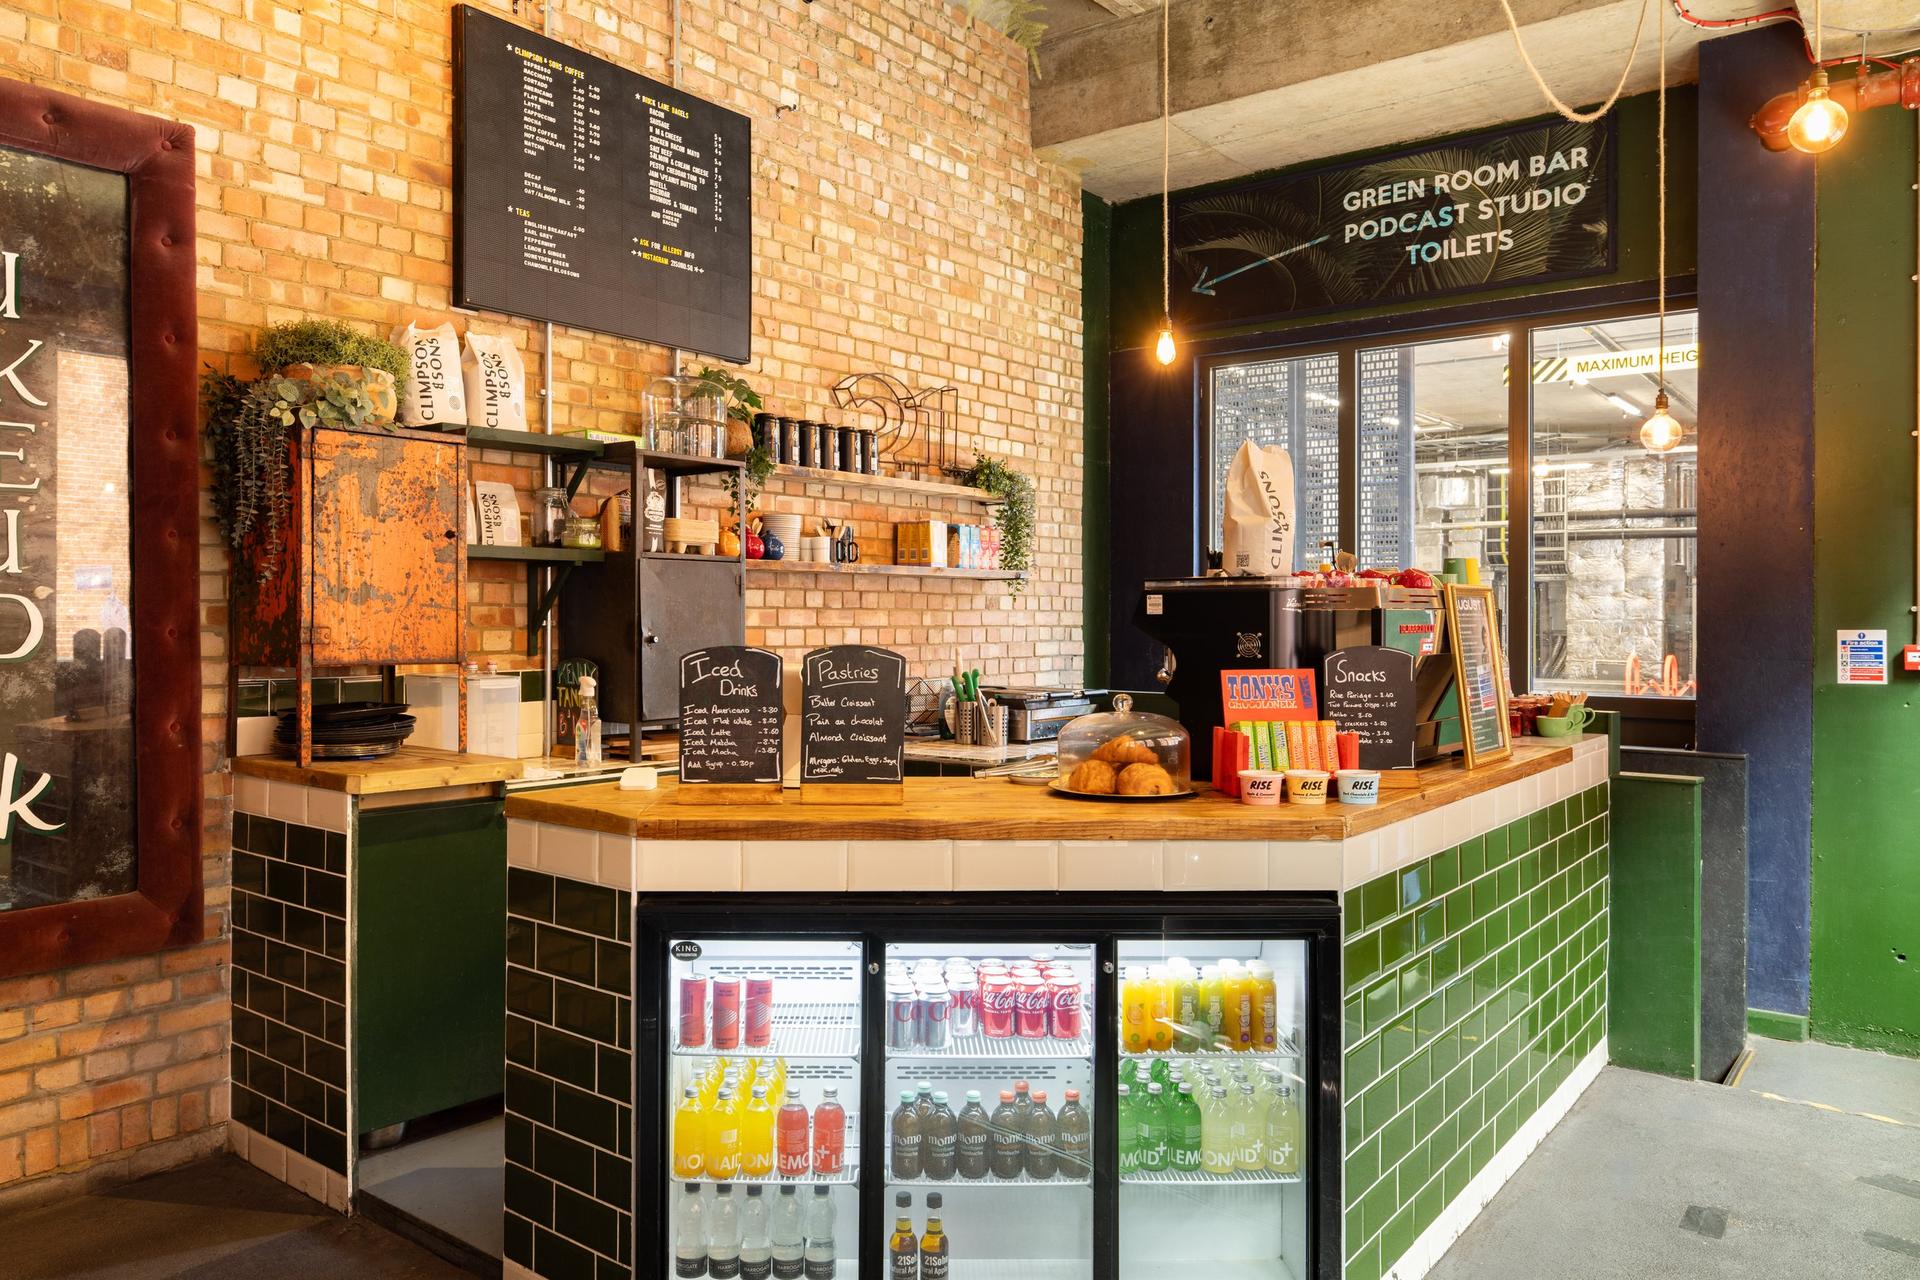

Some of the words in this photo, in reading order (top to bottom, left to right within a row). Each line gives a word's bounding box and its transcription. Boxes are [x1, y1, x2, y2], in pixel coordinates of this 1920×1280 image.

[514, 47, 543, 64] CLIMPSON
[548, 60, 562, 71] SONS
[564, 66, 584, 80] COFFEE
[523, 60, 551, 74] ESPRESSO
[523, 76, 548, 88] CORTADO
[523, 84, 552, 98] AMERICANO
[524, 92, 538, 102] FLAT
[524, 100, 541, 110] LATTE
[658, 102, 670, 112] LANE
[672, 106, 688, 119] BAGELS
[524, 108, 556, 124] CAPPUCCINO
[649, 108, 664, 118] BACON
[524, 124, 536, 132] ICED
[537, 128, 558, 140] COFFEE
[665, 132, 682, 144] CHEESE
[524, 140, 544, 151] MATCHA
[536, 136, 566, 150] CHOCOLATE
[650, 135, 669, 148] CHICKEN
[670, 142, 686, 153] BACON
[524, 148, 536, 156] CHAI
[650, 160, 664, 172] PESTO
[674, 160, 690, 171] CREAM
[692, 166, 709, 178] CHEESE
[524, 172, 542, 181] DECAF
[1343, 178, 1425, 214] GREEN
[1433, 158, 1520, 195] ROOM
[1529, 146, 1588, 176] BAR
[524, 180, 542, 190] EXTRA
[680, 180, 698, 191] BUTTER
[516, 208, 530, 218] TEAS
[679, 202, 698, 214] TOMATO
[1344, 202, 1466, 244] PODCAST
[1478, 182, 1587, 221] STUDIO
[524, 220, 546, 230] ENGLISH
[548, 226, 578, 238] BREAKFAST
[524, 228, 538, 236] EARL
[540, 232, 554, 240] GREY
[524, 236, 556, 248] PEPPERMINT
[640, 238, 650, 248] ASK
[651, 242, 660, 250] FOR
[662, 244, 682, 256] ALLERGY
[1406, 228, 1515, 266] TOILETS
[524, 244, 542, 254] LEMON
[548, 248, 566, 259] GINGER
[552, 257, 570, 268] GREEN
[642, 252, 669, 265] INSTAGRAM
[554, 267, 580, 278] BLOSSOMS
[1576, 354, 1653, 373] MAXIMUM
[414, 336, 434, 420] CLIMPSON
[480, 492, 494, 546] CLIMPSON
[1456, 600, 1482, 611] UGUST
[690, 657, 744, 684] Iced
[818, 659, 879, 682] Pastries
[1335, 660, 1386, 683] Snacks
[720, 679, 758, 697] Drinks
[557, 686, 582, 708] TAN
[840, 696, 876, 708] Croissant
[684, 704, 708, 715] Iced
[711, 704, 750, 714] Americano
[684, 717, 708, 726] Iced
[806, 713, 830, 726] Pain
[850, 714, 884, 726] chocolat
[683, 738, 707, 746] Iced
[710, 738, 738, 747] Matcha
[808, 732, 845, 742] Almond
[850, 732, 887, 744] Croissant
[683, 748, 708, 756] Iced
[712, 748, 740, 757] Mocha
[1250, 780, 1272, 790] RISE
[1300, 780, 1323, 790] RISE
[1352, 780, 1374, 790] RISE
[928, 1134, 957, 1146] momo
